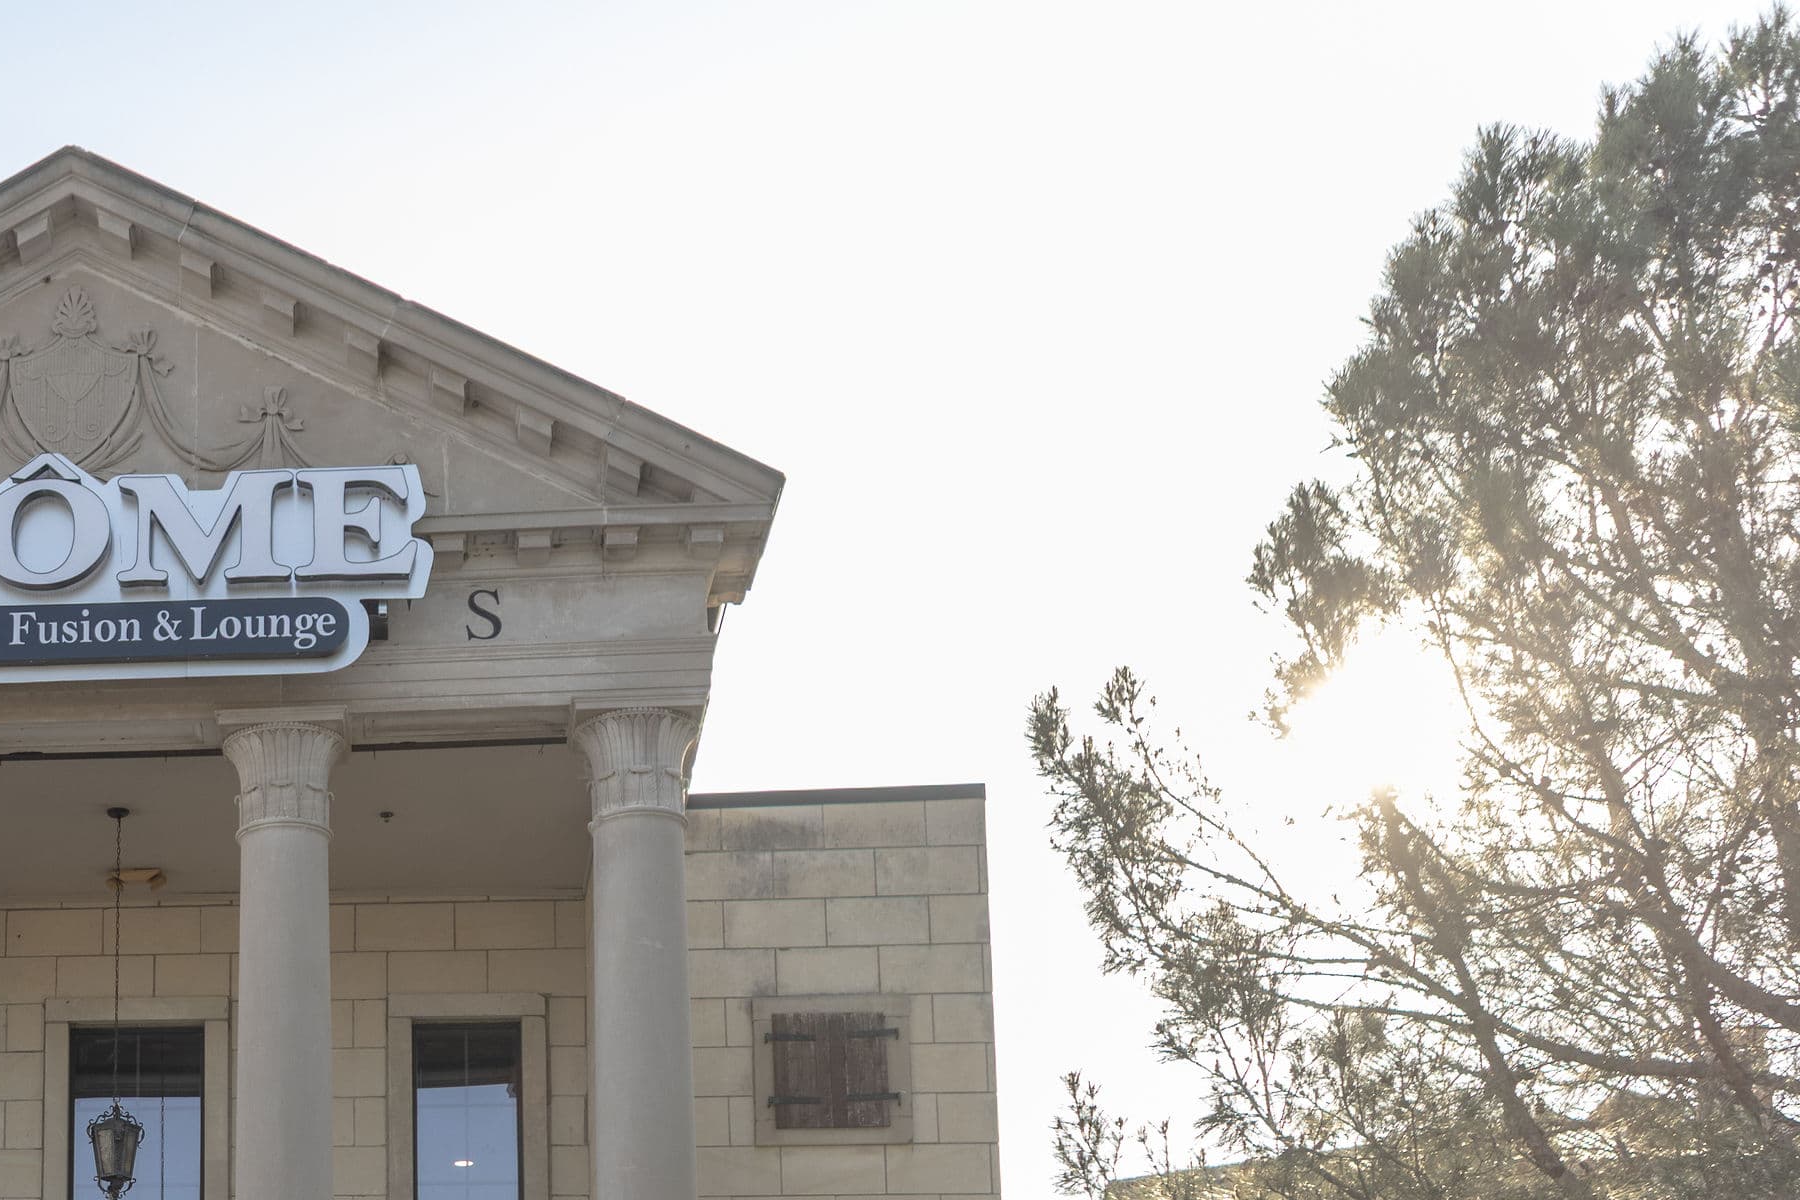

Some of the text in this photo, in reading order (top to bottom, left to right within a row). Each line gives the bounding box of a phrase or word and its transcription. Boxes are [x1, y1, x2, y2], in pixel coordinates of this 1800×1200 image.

[8, 608, 143, 646] Fusion
[153, 609, 183, 642] &
[189, 605, 338, 650] Lounge
